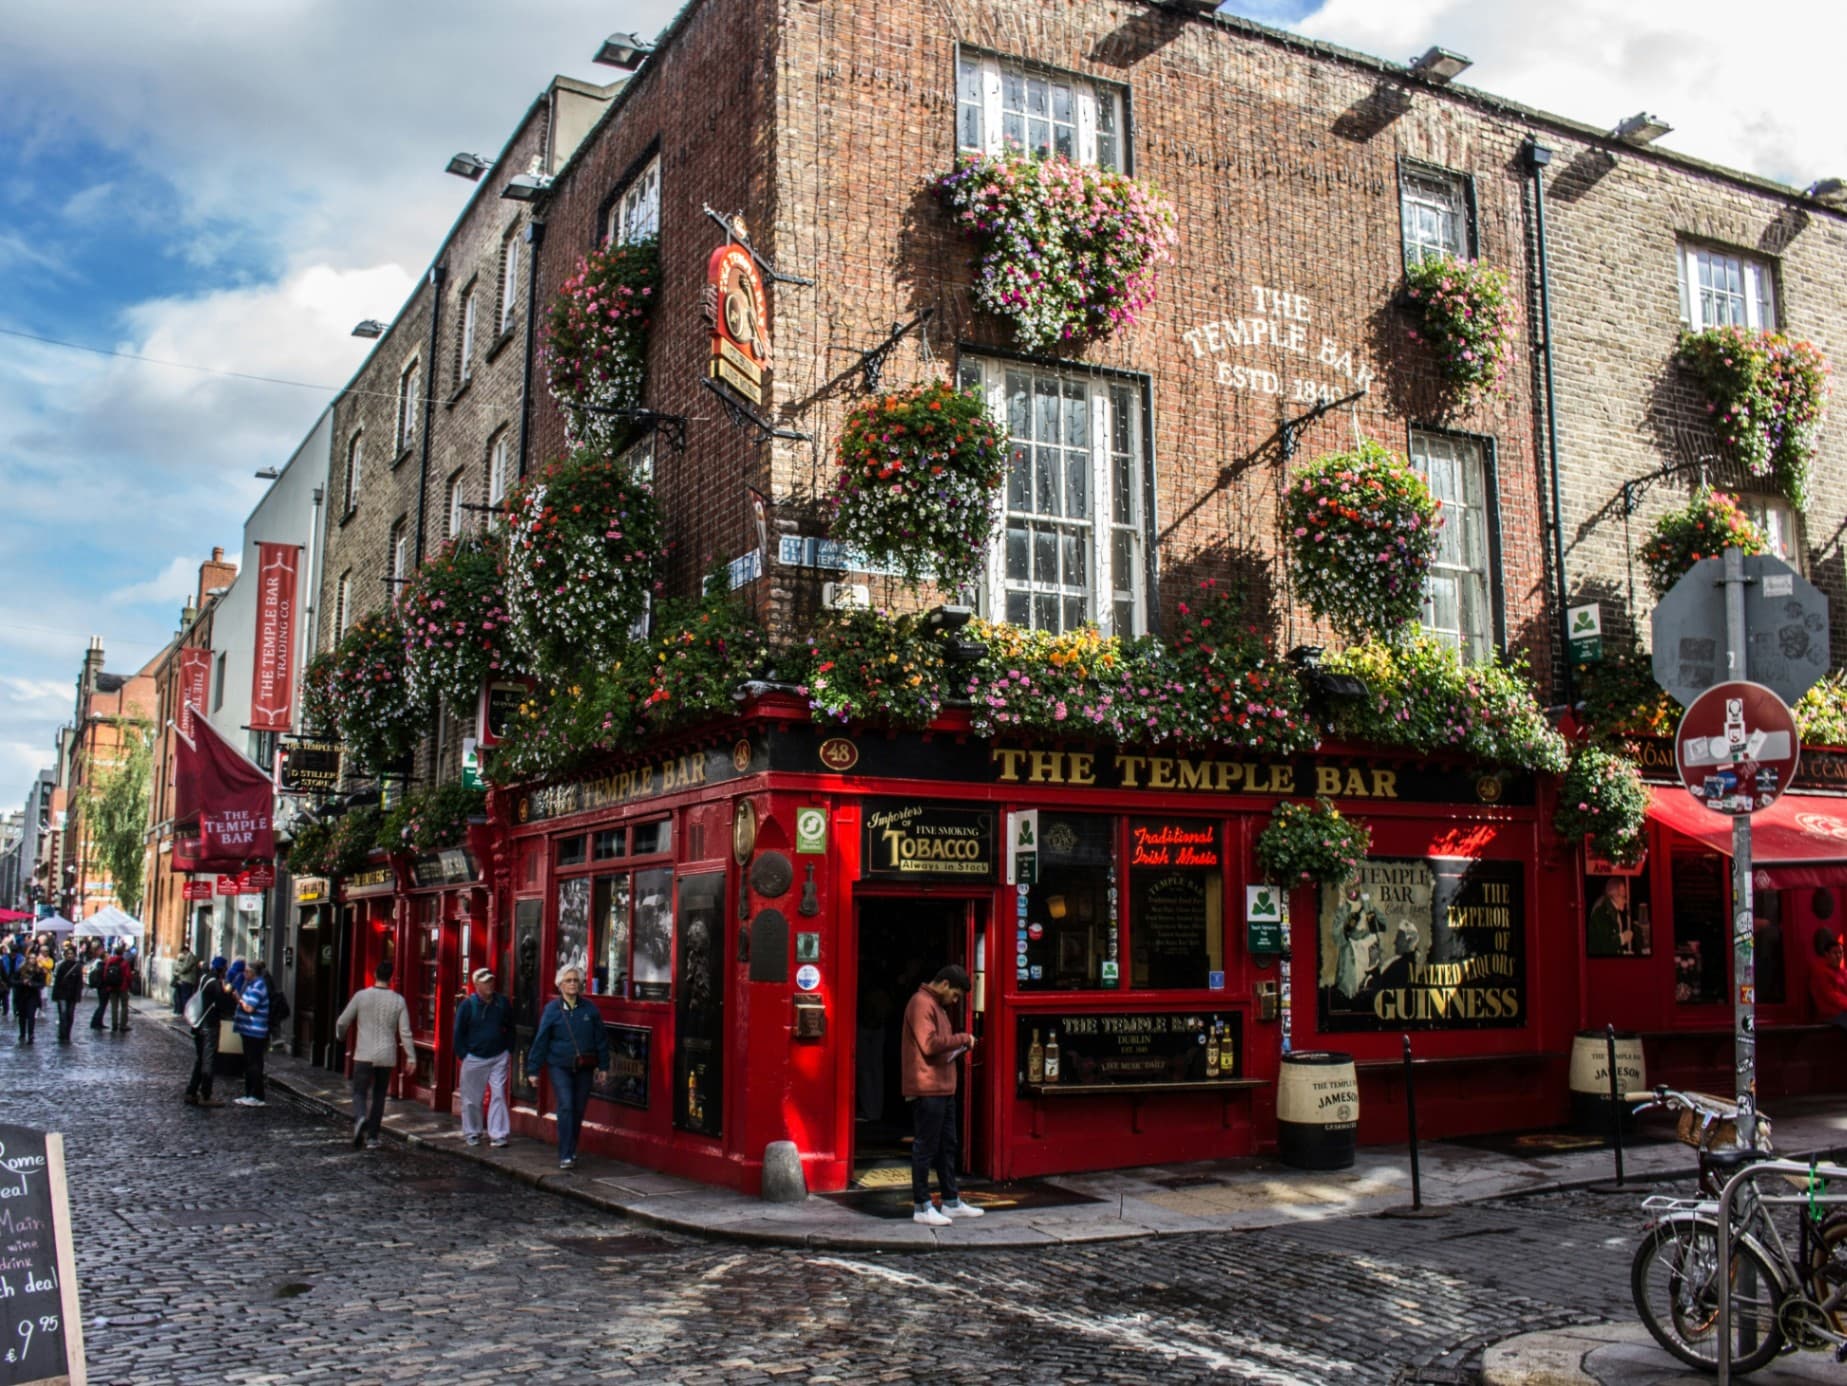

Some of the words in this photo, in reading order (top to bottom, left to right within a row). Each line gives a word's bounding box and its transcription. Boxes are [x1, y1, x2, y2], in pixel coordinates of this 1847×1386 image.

[1252, 285, 1311, 323] THE
[1183, 319, 1307, 358] TEMPLE
[1317, 336, 1374, 393] BAR
[1217, 361, 1284, 394] ESTD.
[266, 576, 279, 605] BAR
[263, 609, 277, 669] TEMPLE
[277, 620, 288, 679] TRADING
[261, 672, 273, 700] THE
[827, 743, 850, 762] 48
[582, 765, 654, 809] TEMPLE
[662, 751, 706, 791] BAR
[993, 748, 1097, 785] THE
[1115, 755, 1296, 793] TEMPLE
[1316, 767, 1398, 798] BAR
[205, 818, 267, 832] TEMPLE
[223, 810, 249, 820] THE
[867, 806, 922, 829] Importers
[221, 832, 253, 844] BAR
[916, 825, 936, 834] FINE
[938, 825, 979, 836] SMOKING
[1134, 826, 1213, 845] Traditional
[881, 830, 980, 867] TOBACCO
[1133, 846, 1169, 865] Irish
[1176, 847, 1217, 865] Music
[902, 861, 939, 871] Always
[944, 862, 954, 871] in
[958, 862, 987, 873] Stock
[1361, 867, 1429, 886] TEMPLE
[1380, 886, 1415, 904] BAR
[1482, 882, 1510, 903] THE
[1447, 905, 1510, 928] EMPEROR
[1495, 931, 1511, 951] OF
[1408, 961, 1462, 985] MALTED
[1463, 953, 1516, 981] LIQUORS
[1374, 987, 1519, 1020] GUINNESS
[1062, 1017, 1098, 1033] THE
[1101, 1017, 1167, 1033] TEMPLE
[1117, 1035, 1151, 1045] DUBLIN
[1595, 1066, 1640, 1080] JAESON
[1313, 1082, 1328, 1090] THE
[7, 1239, 39, 1252] wine
[24, 1266, 58, 1293] deal
